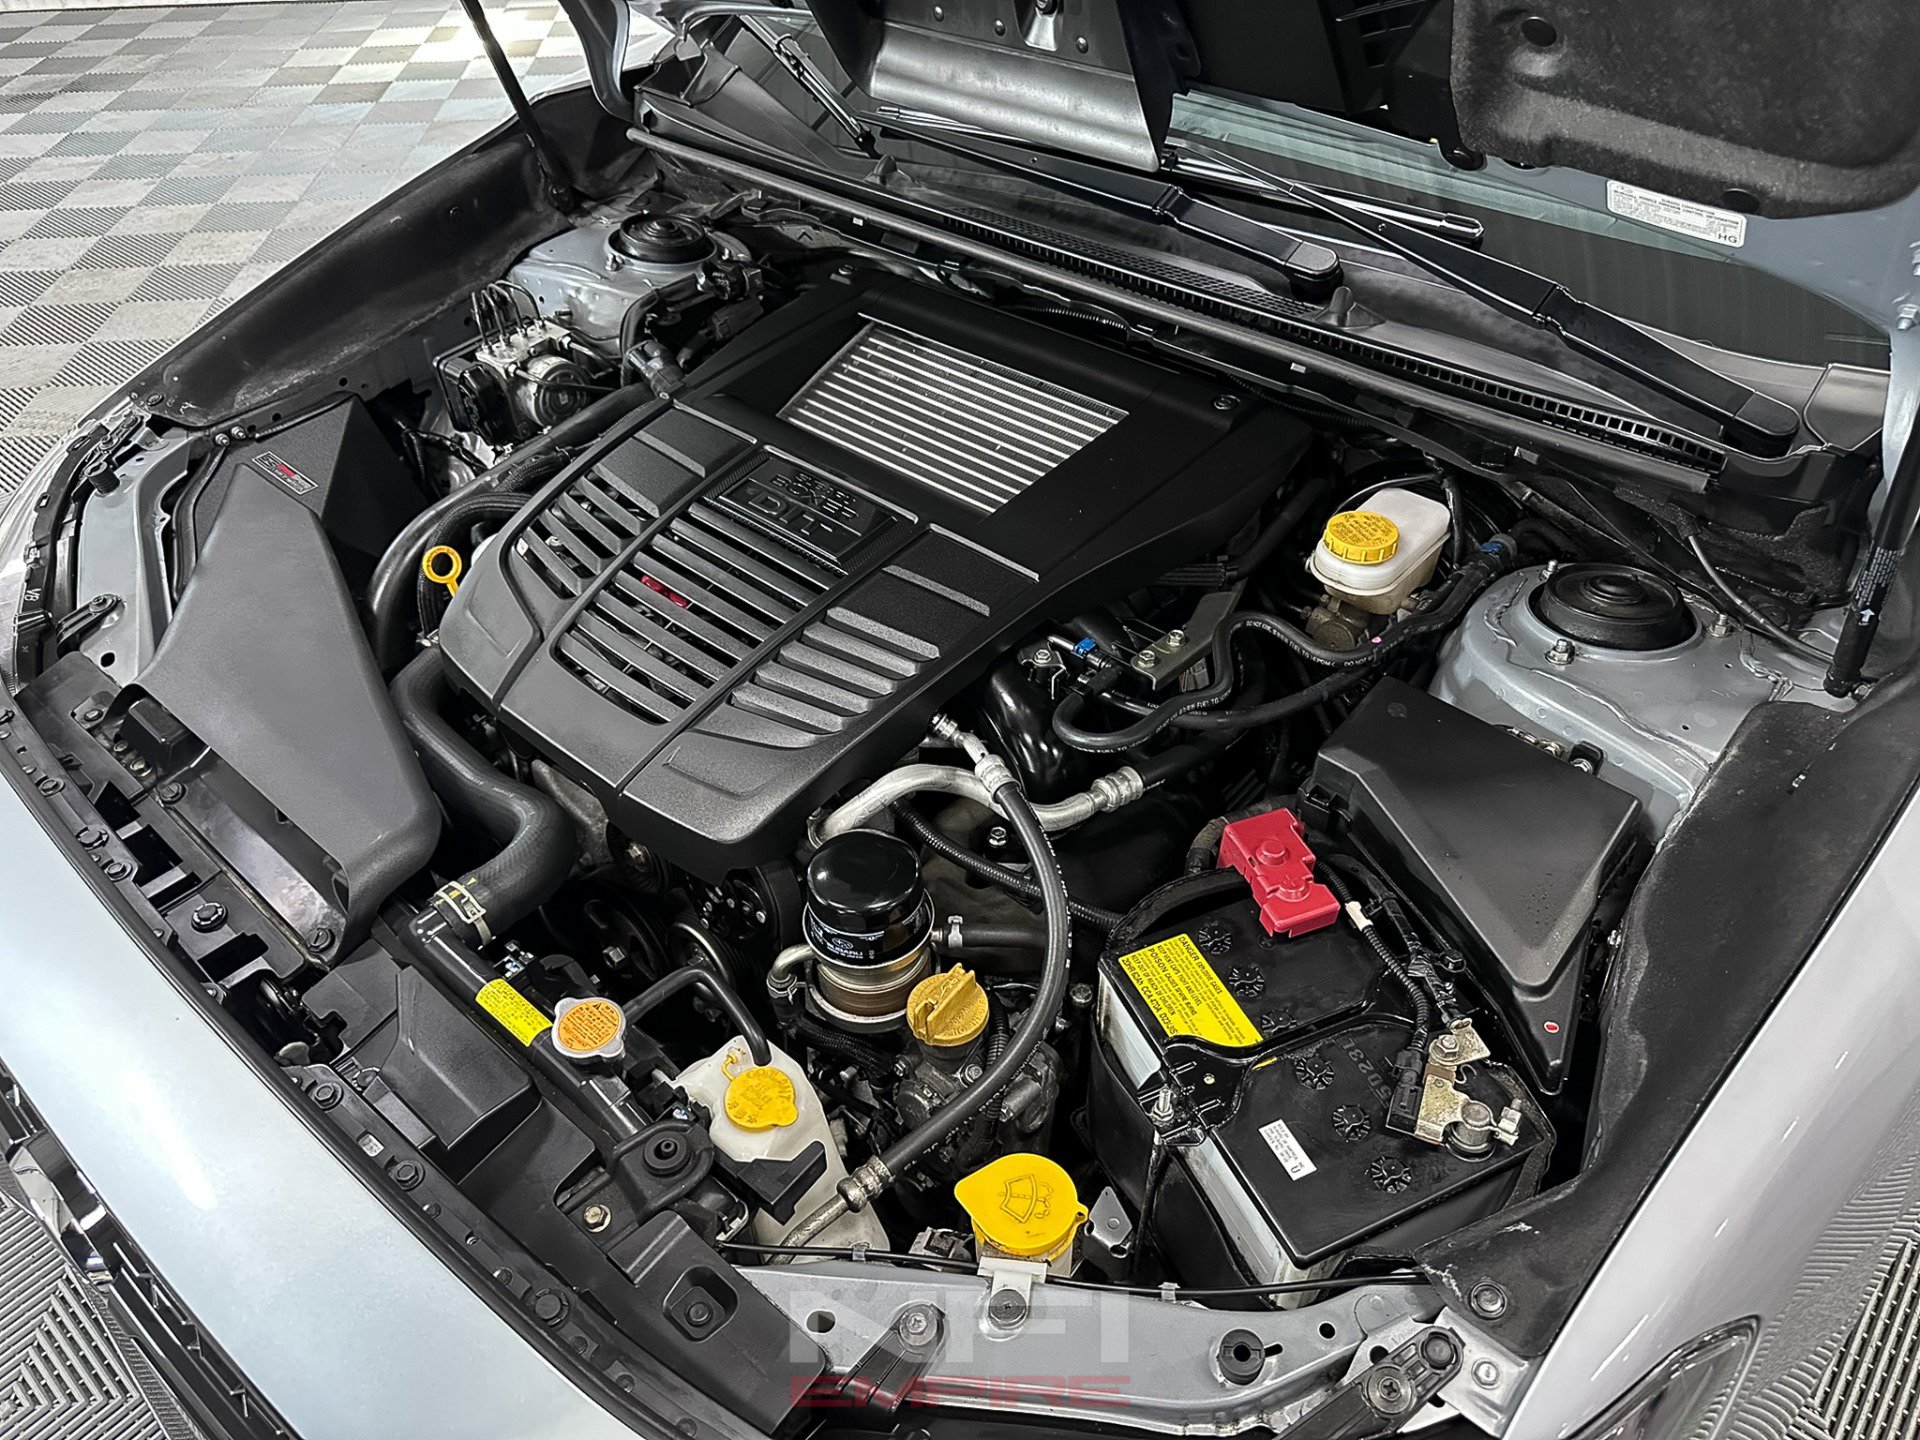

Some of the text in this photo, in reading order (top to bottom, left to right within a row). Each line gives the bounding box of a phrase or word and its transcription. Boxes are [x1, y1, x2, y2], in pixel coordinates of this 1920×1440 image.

[1718, 234, 1737, 244] HG
[770, 474, 860, 518] BOXER
[749, 495, 834, 536] DIT
[1147, 947, 1169, 973] POISON
[1177, 935, 1200, 962] DANGER
[1290, 1164, 1301, 1175] U
